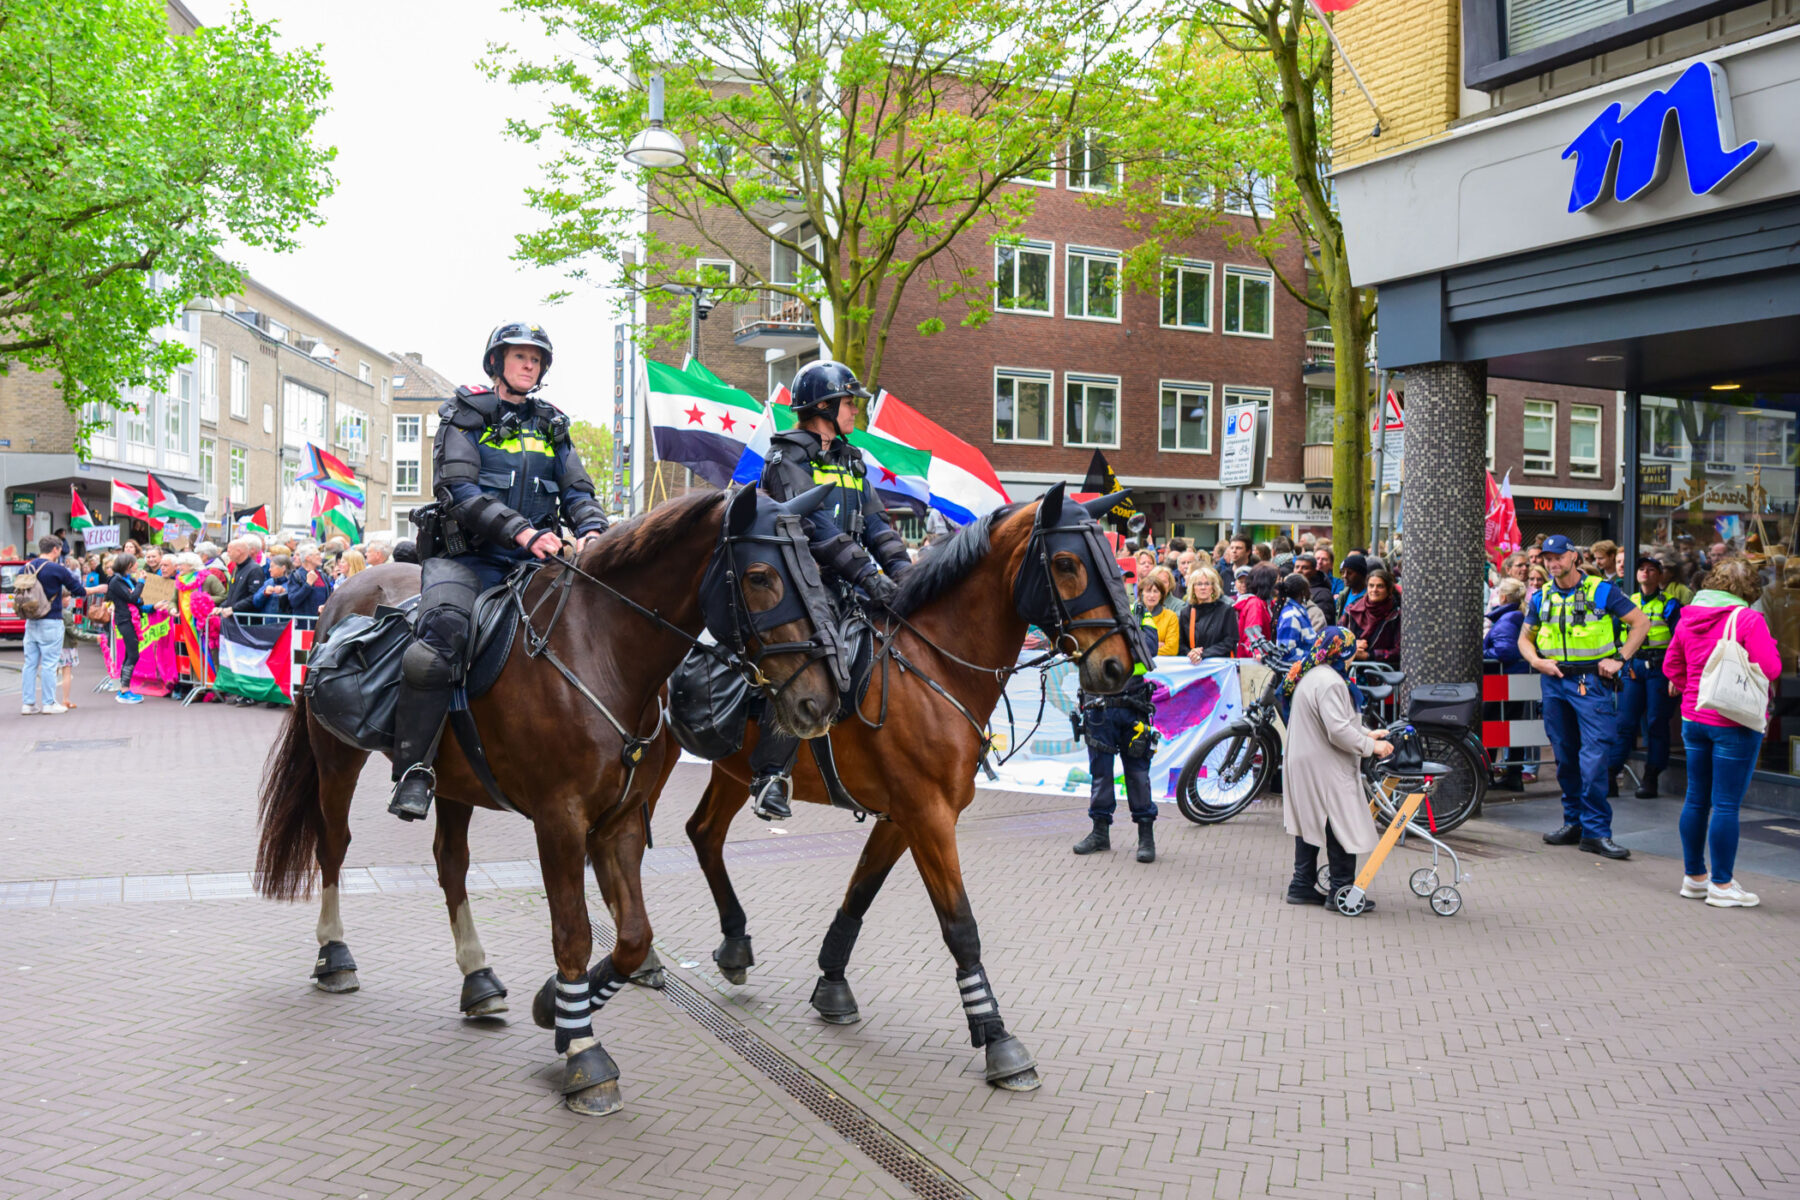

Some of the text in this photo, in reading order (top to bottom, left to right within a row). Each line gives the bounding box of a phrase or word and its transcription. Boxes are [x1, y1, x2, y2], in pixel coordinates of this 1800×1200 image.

[614, 329, 624, 505] AUTOMATIEK
[1640, 465, 1667, 474] EAUTY
[1284, 494, 1304, 509] VY
[1533, 498, 1589, 512] YOU MOBILE
